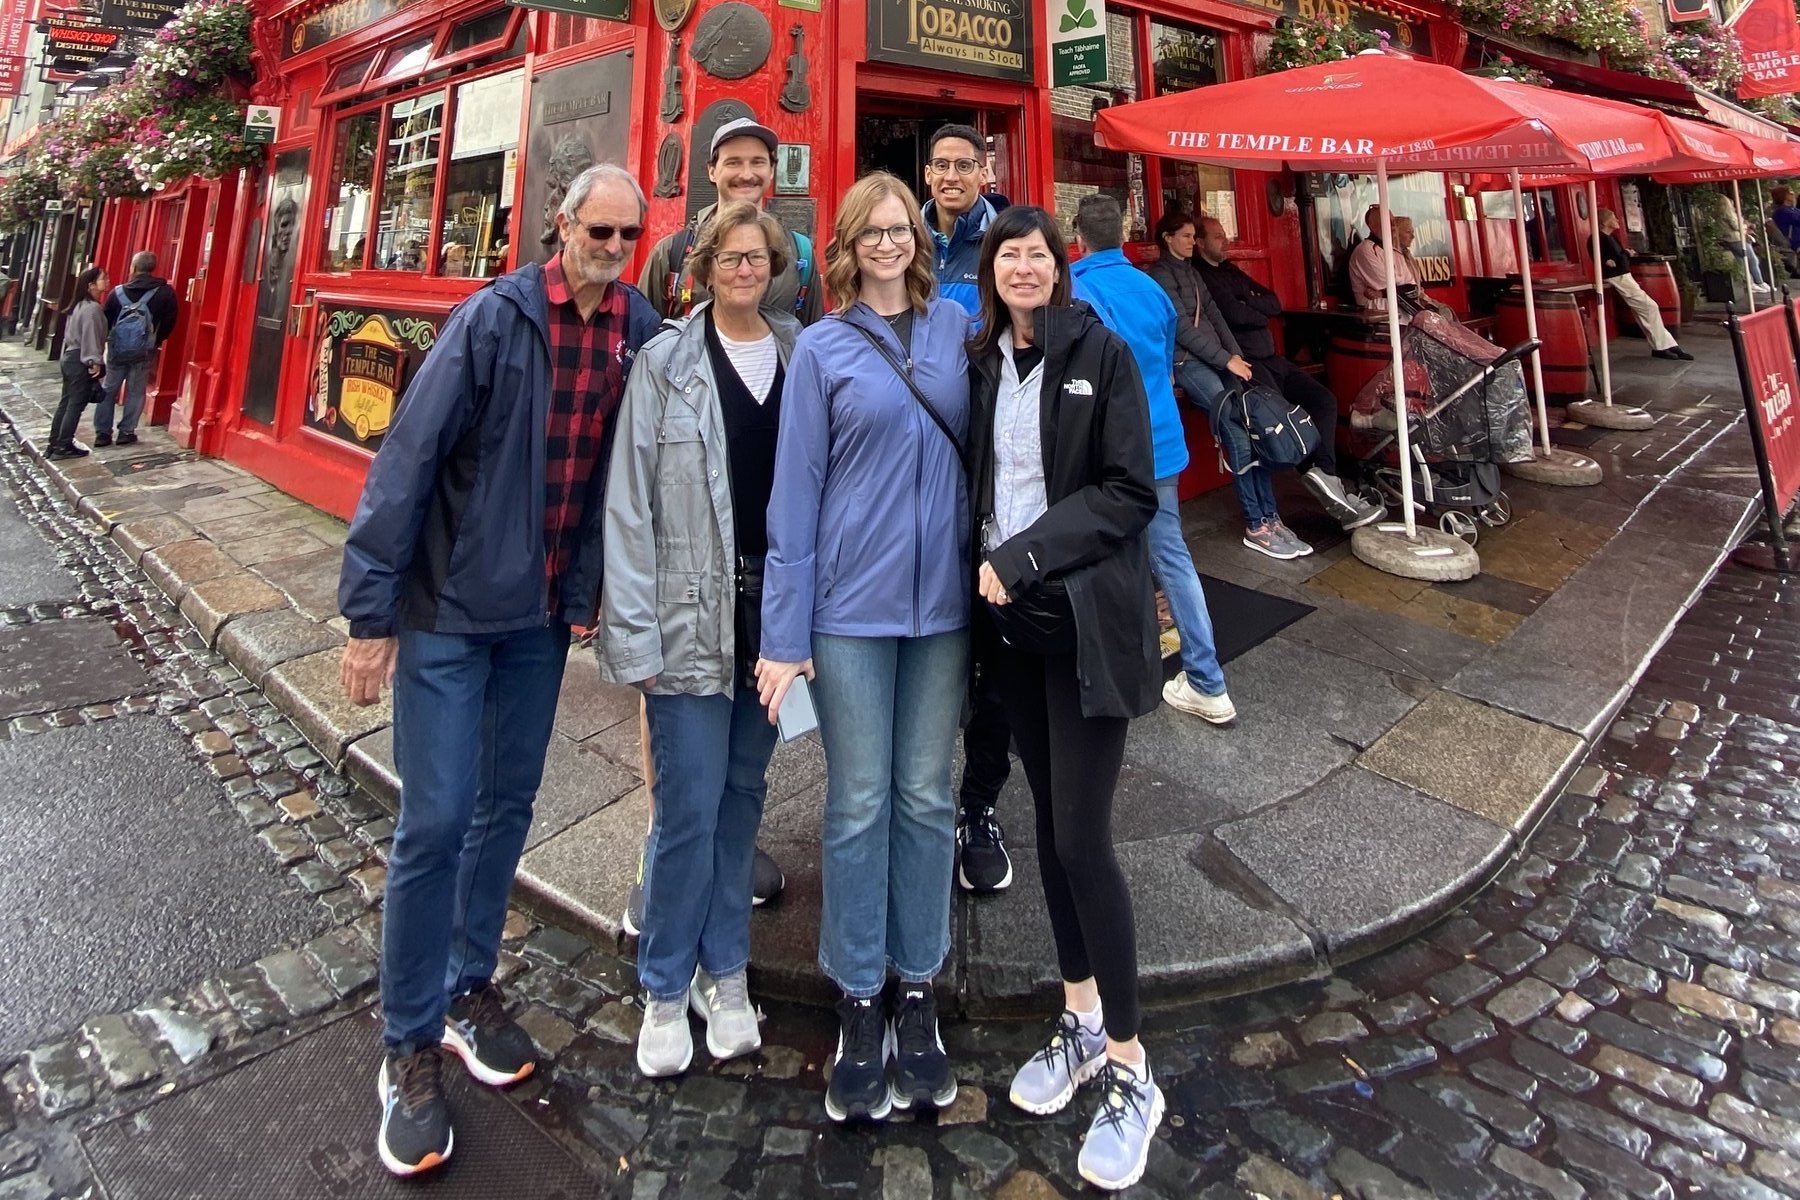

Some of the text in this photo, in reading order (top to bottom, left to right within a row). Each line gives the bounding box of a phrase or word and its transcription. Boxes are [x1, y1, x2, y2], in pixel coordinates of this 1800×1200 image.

[140, 2, 178, 13] MUSIC
[126, 9, 161, 20] DAILY
[47, 18, 66, 26] THE
[51, 28, 117, 44] WHISKEY SHOP
[55, 42, 109, 53] DISTILLERY
[922, 38, 1021, 67] Always in Stock
[1058, 46, 1074, 55] Teach
[64, 55, 96, 63] STORE
[1073, 53, 1084, 61] Pub
[1752, 50, 1780, 61] THE
[1753, 68, 1788, 82] BAR
[1167, 131, 1435, 155] THE TEMPLE BAR EST 1840
[1691, 170, 1714, 179] THE
[364, 345, 377, 359] THE
[346, 357, 395, 386] TEMPLE BAR
